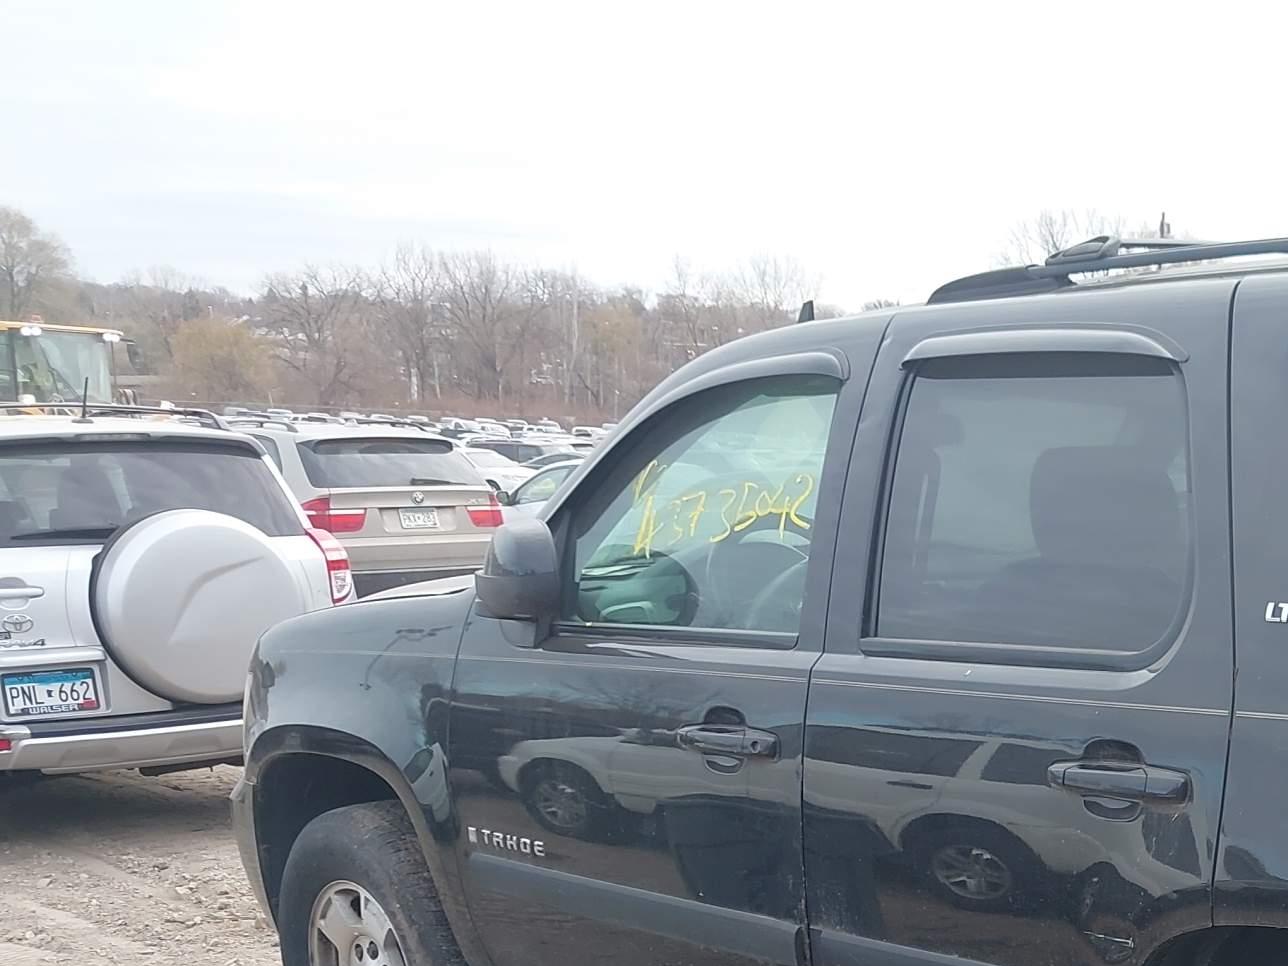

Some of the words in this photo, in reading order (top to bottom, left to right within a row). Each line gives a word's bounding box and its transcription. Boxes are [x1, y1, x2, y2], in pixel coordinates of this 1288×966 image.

[8, 685, 45, 707] PNL
[58, 680, 93, 703] 662
[28, 703, 80, 715] WALSER
[480, 828, 545, 857] TAHOE
